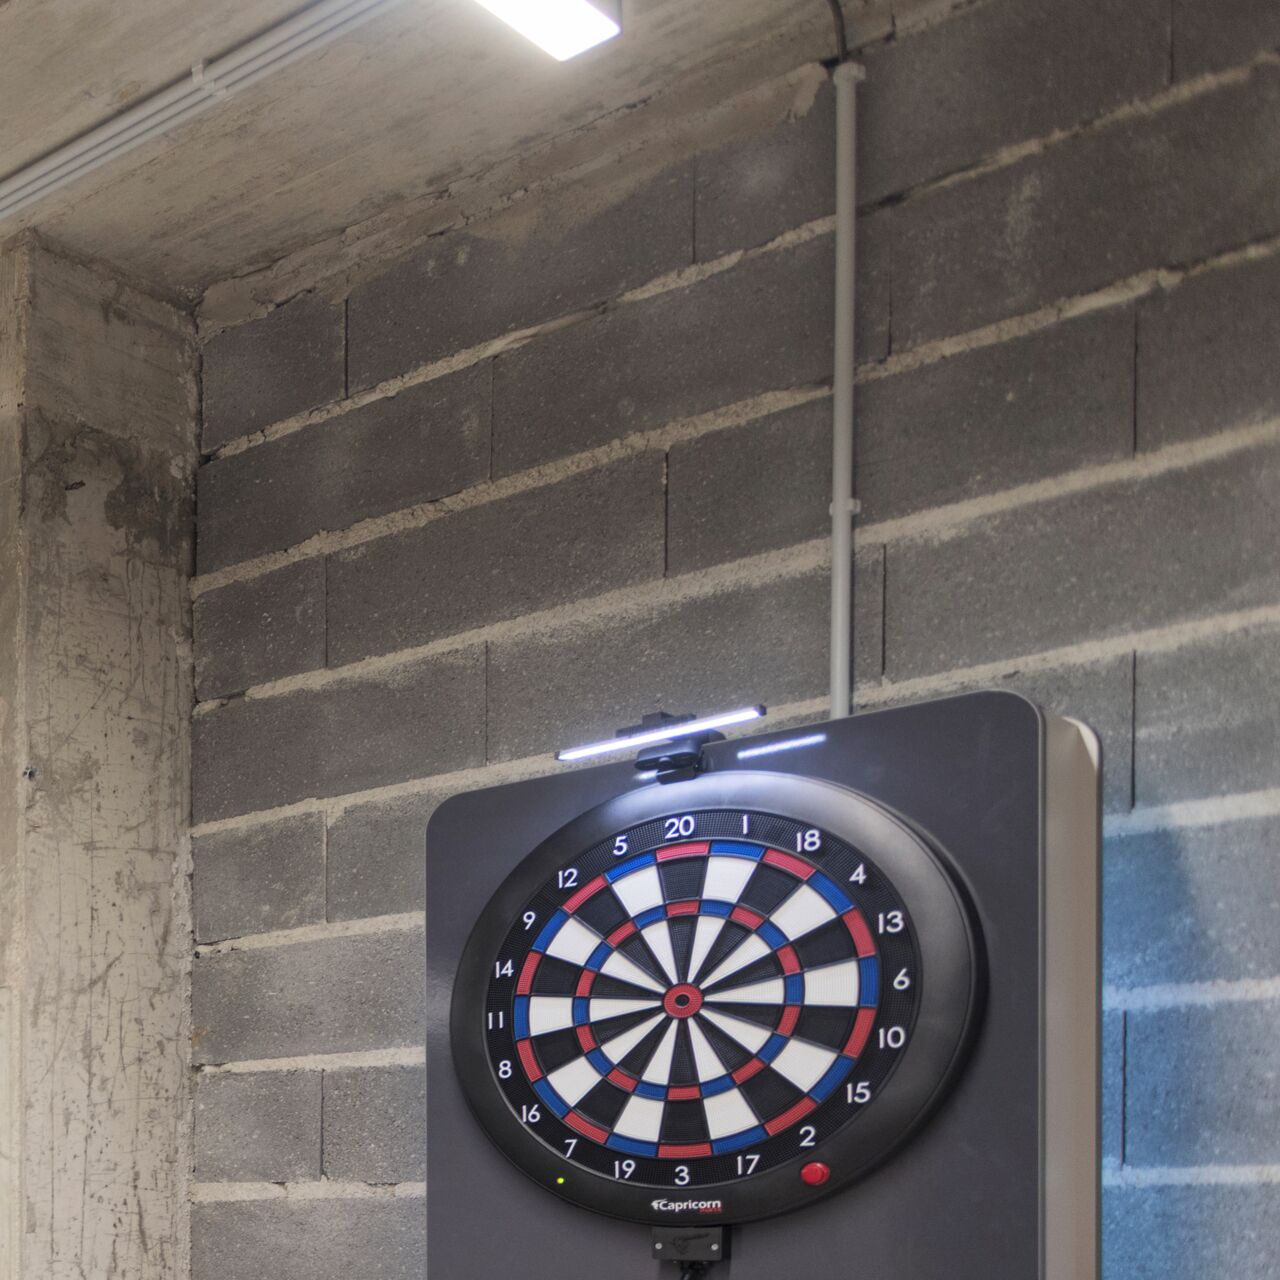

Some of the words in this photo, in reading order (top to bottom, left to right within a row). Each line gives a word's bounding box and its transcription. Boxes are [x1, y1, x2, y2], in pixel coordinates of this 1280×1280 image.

[664, 815, 696, 840] 20
[742, 813, 749, 835] 1
[612, 835, 629, 856] 5
[796, 828, 821, 853] 18
[558, 867, 578, 889] 12
[848, 863, 867, 885] 4
[522, 911, 536, 931] 9
[878, 910, 904, 934] 13
[495, 959, 514, 979] 14
[892, 967, 910, 990] 6
[488, 1011, 504, 1030] 11
[878, 1026, 906, 1049] 10
[498, 1059, 512, 1079] 8
[846, 1081, 871, 1104] 15
[521, 1104, 541, 1123] 16
[799, 1125, 816, 1147] 2
[565, 1138, 578, 1159] 7
[614, 1159, 636, 1179] 19
[736, 1154, 761, 1175] 17
[674, 1165, 690, 1186] 3
[658, 1199, 722, 1213] Capricorn
